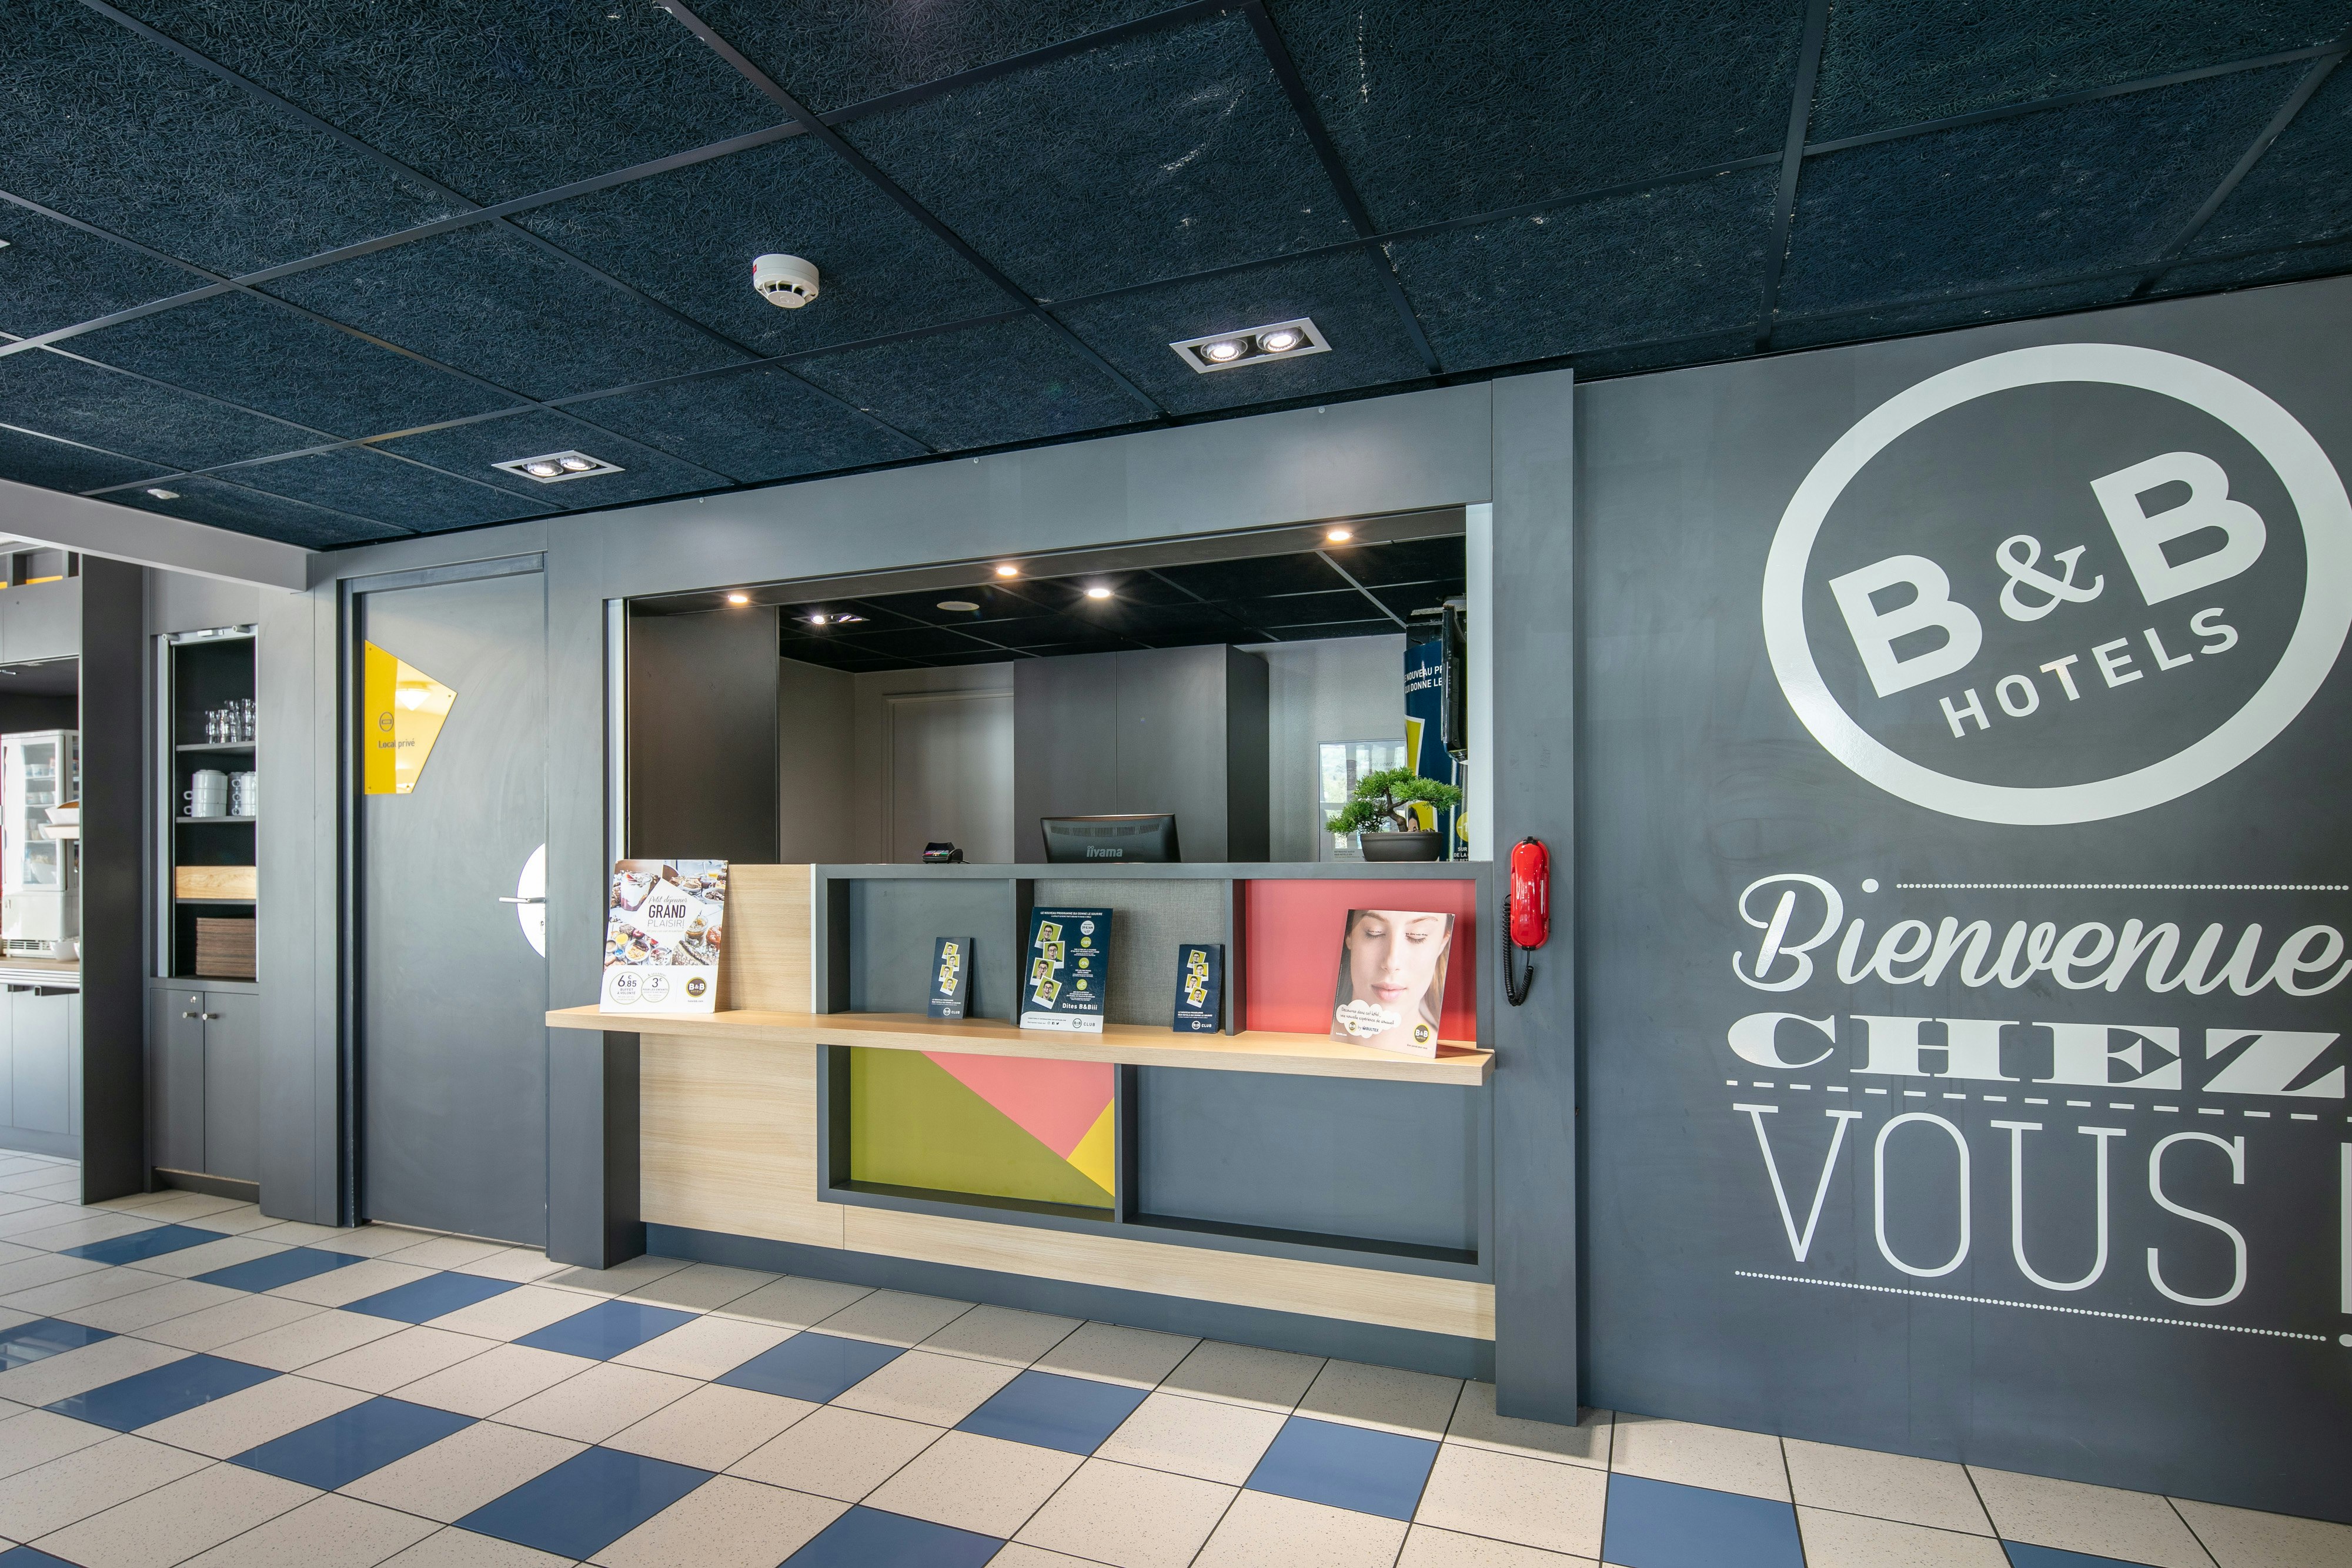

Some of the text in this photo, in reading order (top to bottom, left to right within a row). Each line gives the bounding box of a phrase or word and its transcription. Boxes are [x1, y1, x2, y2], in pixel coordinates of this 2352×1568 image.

[1829, 452, 2267, 698] B&B
[1406, 667, 1432, 681] NOUVEAU
[1939, 608, 2239, 738] HOTELS
[1411, 679, 1432, 692] DONNE
[1434, 677, 1442, 687] LE
[378, 738, 415, 749] Local privé
[1086, 845, 1123, 857] iiyama
[649, 895, 663, 904] Petit
[649, 904, 686, 918] GRAND
[647, 919, 685, 929] PLAISIR!
[1732, 874, 2352, 997] Bienvenue
[652, 977, 659, 988] 3
[1415, 1029, 1428, 1038] B&B
[1728, 1012, 2345, 1099] CHEZ
[1733, 1103, 2247, 1306] VOUS
